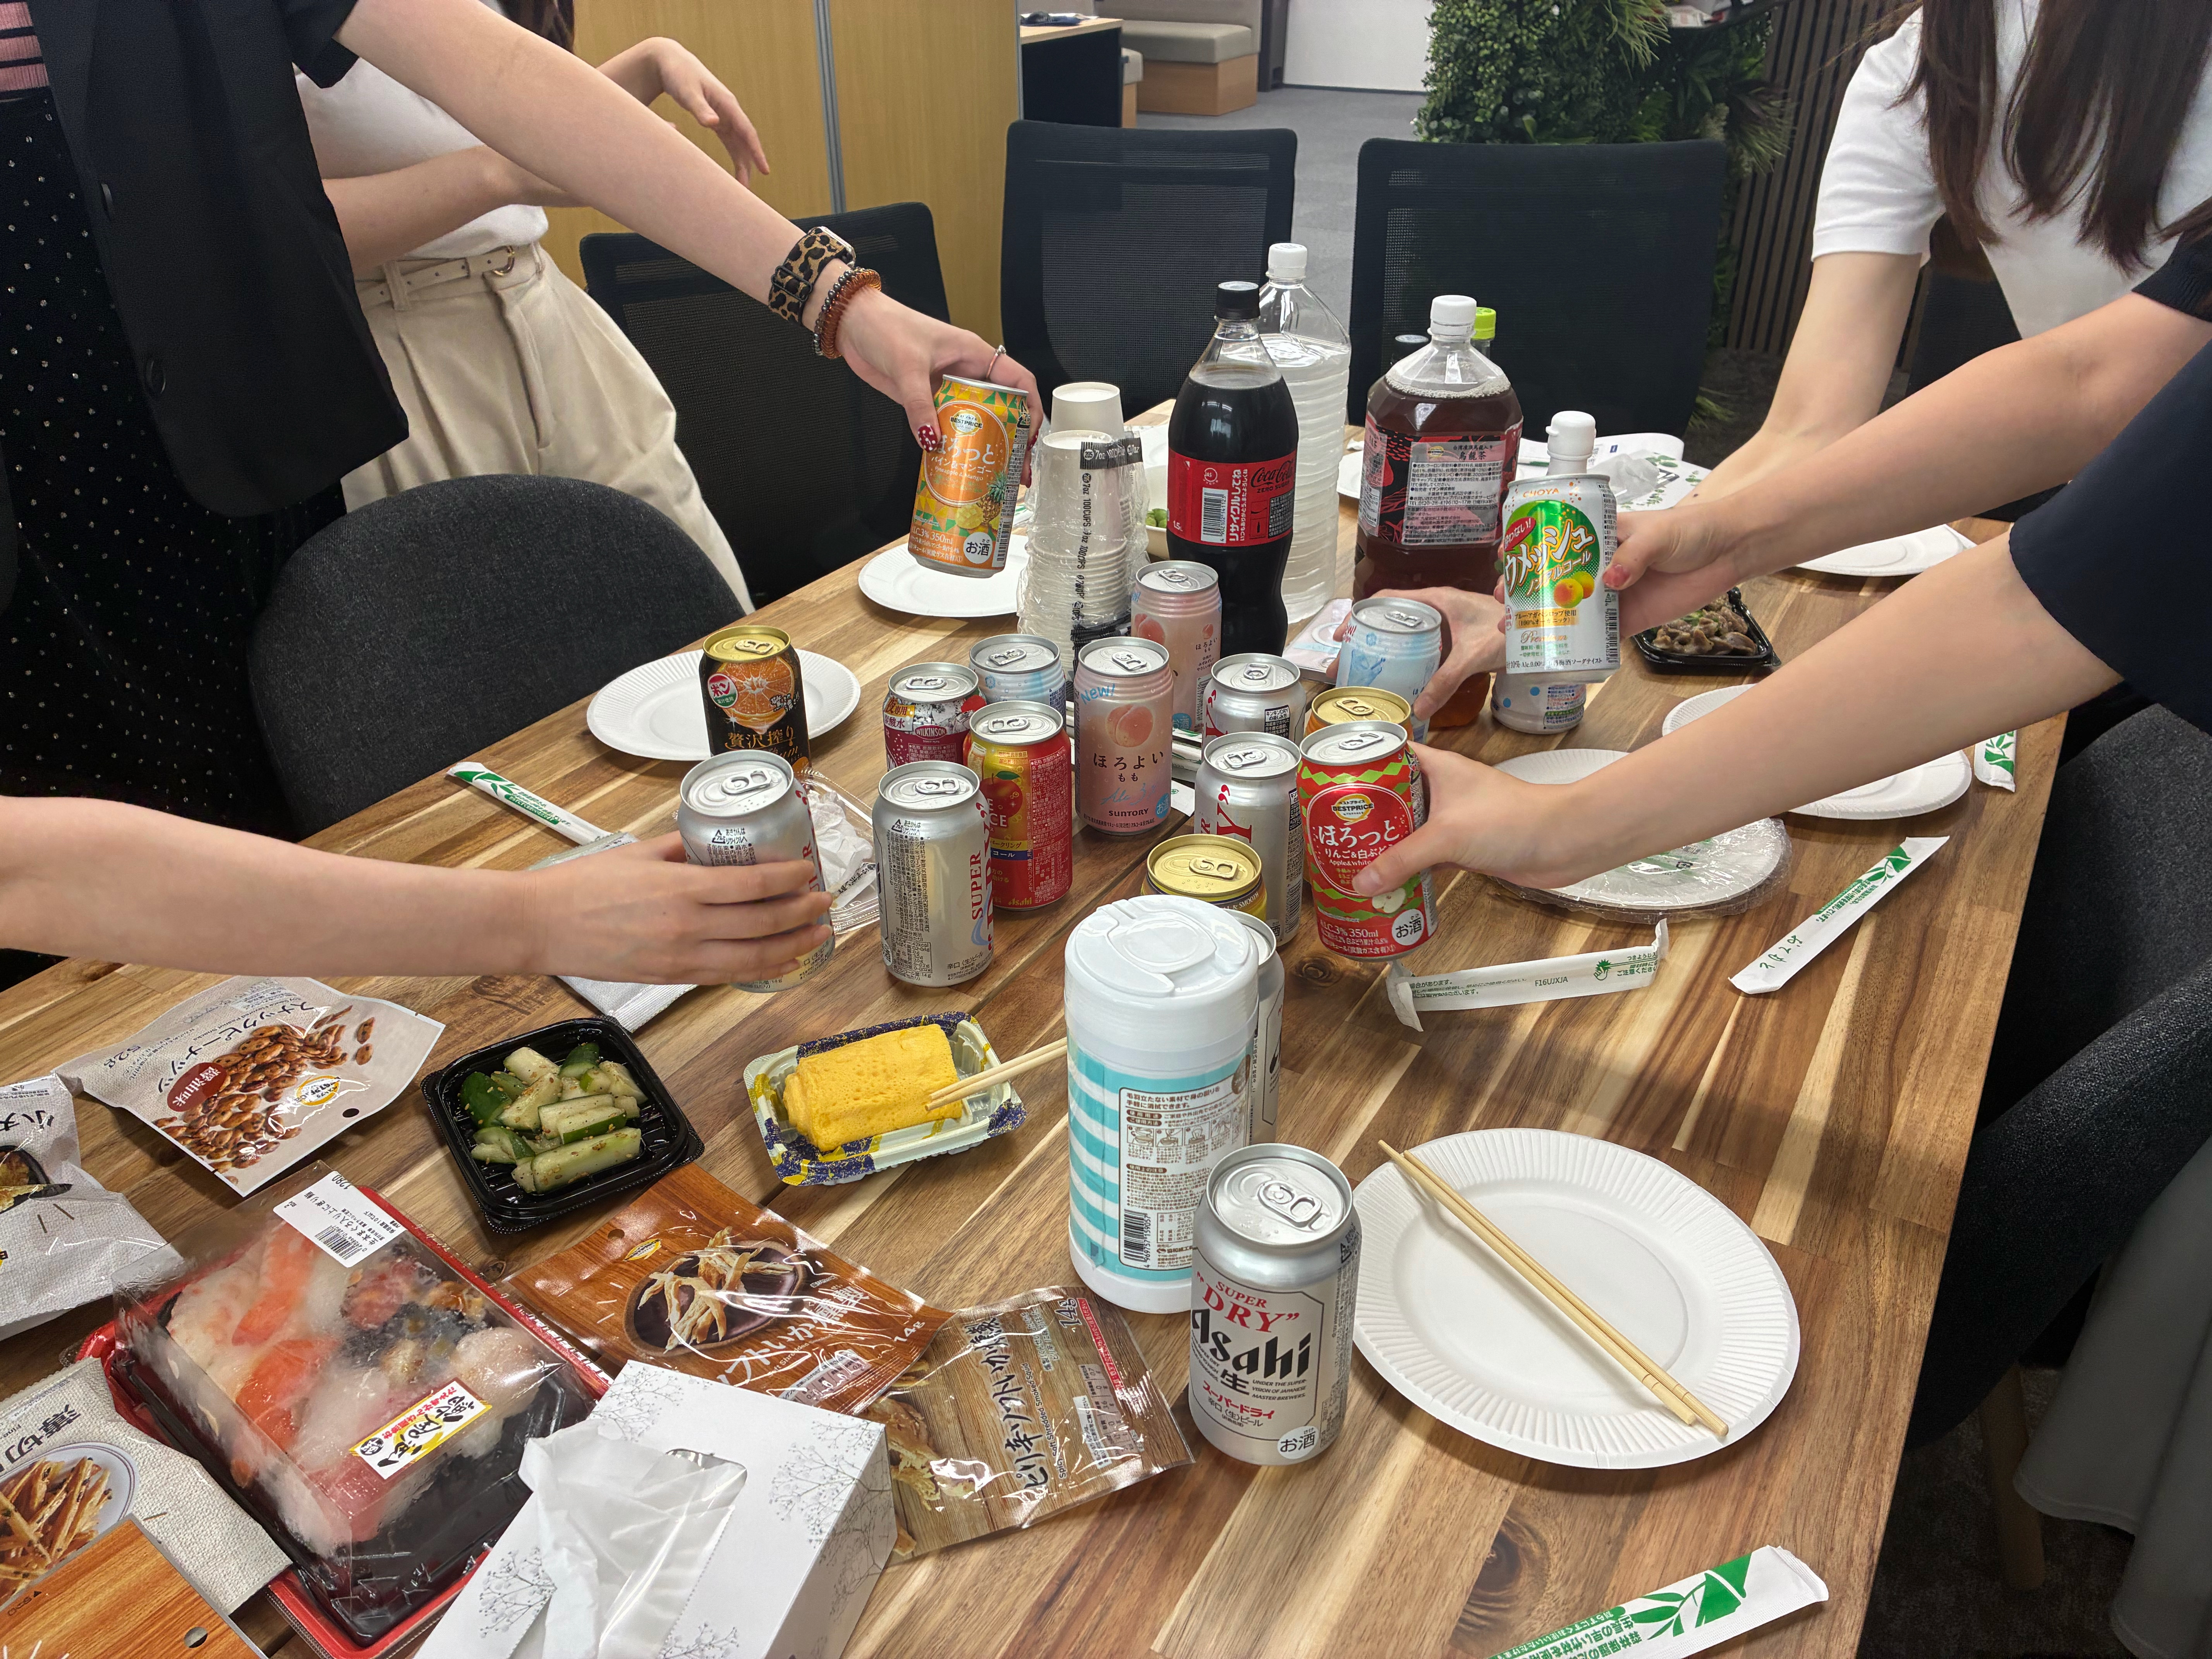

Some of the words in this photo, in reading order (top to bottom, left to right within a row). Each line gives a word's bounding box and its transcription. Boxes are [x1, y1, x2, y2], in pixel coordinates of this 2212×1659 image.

[1458, 450, 1487, 461] 烏龍茶
[1523, 488, 1559, 498] CHOYA
[1083, 498, 1091, 527] 100CUPS
[1229, 469, 1241, 541] リサイクルしてね
[966, 541, 991, 556] お酒
[1506, 520, 1595, 595] ウメッシュ
[1526, 550, 1592, 596] ノンアルコール
[1195, 637, 1218, 650] ほろよい
[916, 727, 945, 737] WILKINSON
[1093, 751, 1164, 771] ほろよい
[1118, 773, 1138, 782] もも
[1108, 807, 1149, 817] SUNTORY
[1333, 803, 1374, 812] BESTPRICE
[1318, 820, 1400, 848] ほろっと
[1325, 844, 1394, 859] りんご&白ぶど
[970, 850, 983, 920] SUPER
[1008, 897, 1032, 906] Asahi
[1239, 891, 1259, 908] SMOOTH
[1349, 928, 1379, 938] 350ml
[1395, 916, 1423, 938] お酒
[1759, 934, 1803, 969] おてもと
[103, 1043, 141, 1070] 52g
[172, 1066, 222, 1108] 醤油味
[304, 1191, 376, 1246] 生本まぐろ入り上にぎり鮨
[1216, 1281, 1268, 1309] SUPER
[1054, 1297, 1082, 1329] 14g
[893, 1320, 926, 1342] 14g
[1192, 1308, 1311, 1379] Asahi
[1022, 1363, 1034, 1381] Squid
[1220, 1369, 1249, 1396] 生
[1252, 1379, 1273, 1387] UNDER
[1030, 1380, 1042, 1408] Smoked
[1202, 1380, 1275, 1420] スーパードライ
[1279, 1385, 1306, 1393] JAPANESE
[1040, 1408, 1054, 1440] Shredded
[0, 1403, 81, 1472] 薄切
[1279, 1431, 1316, 1453] お酒
